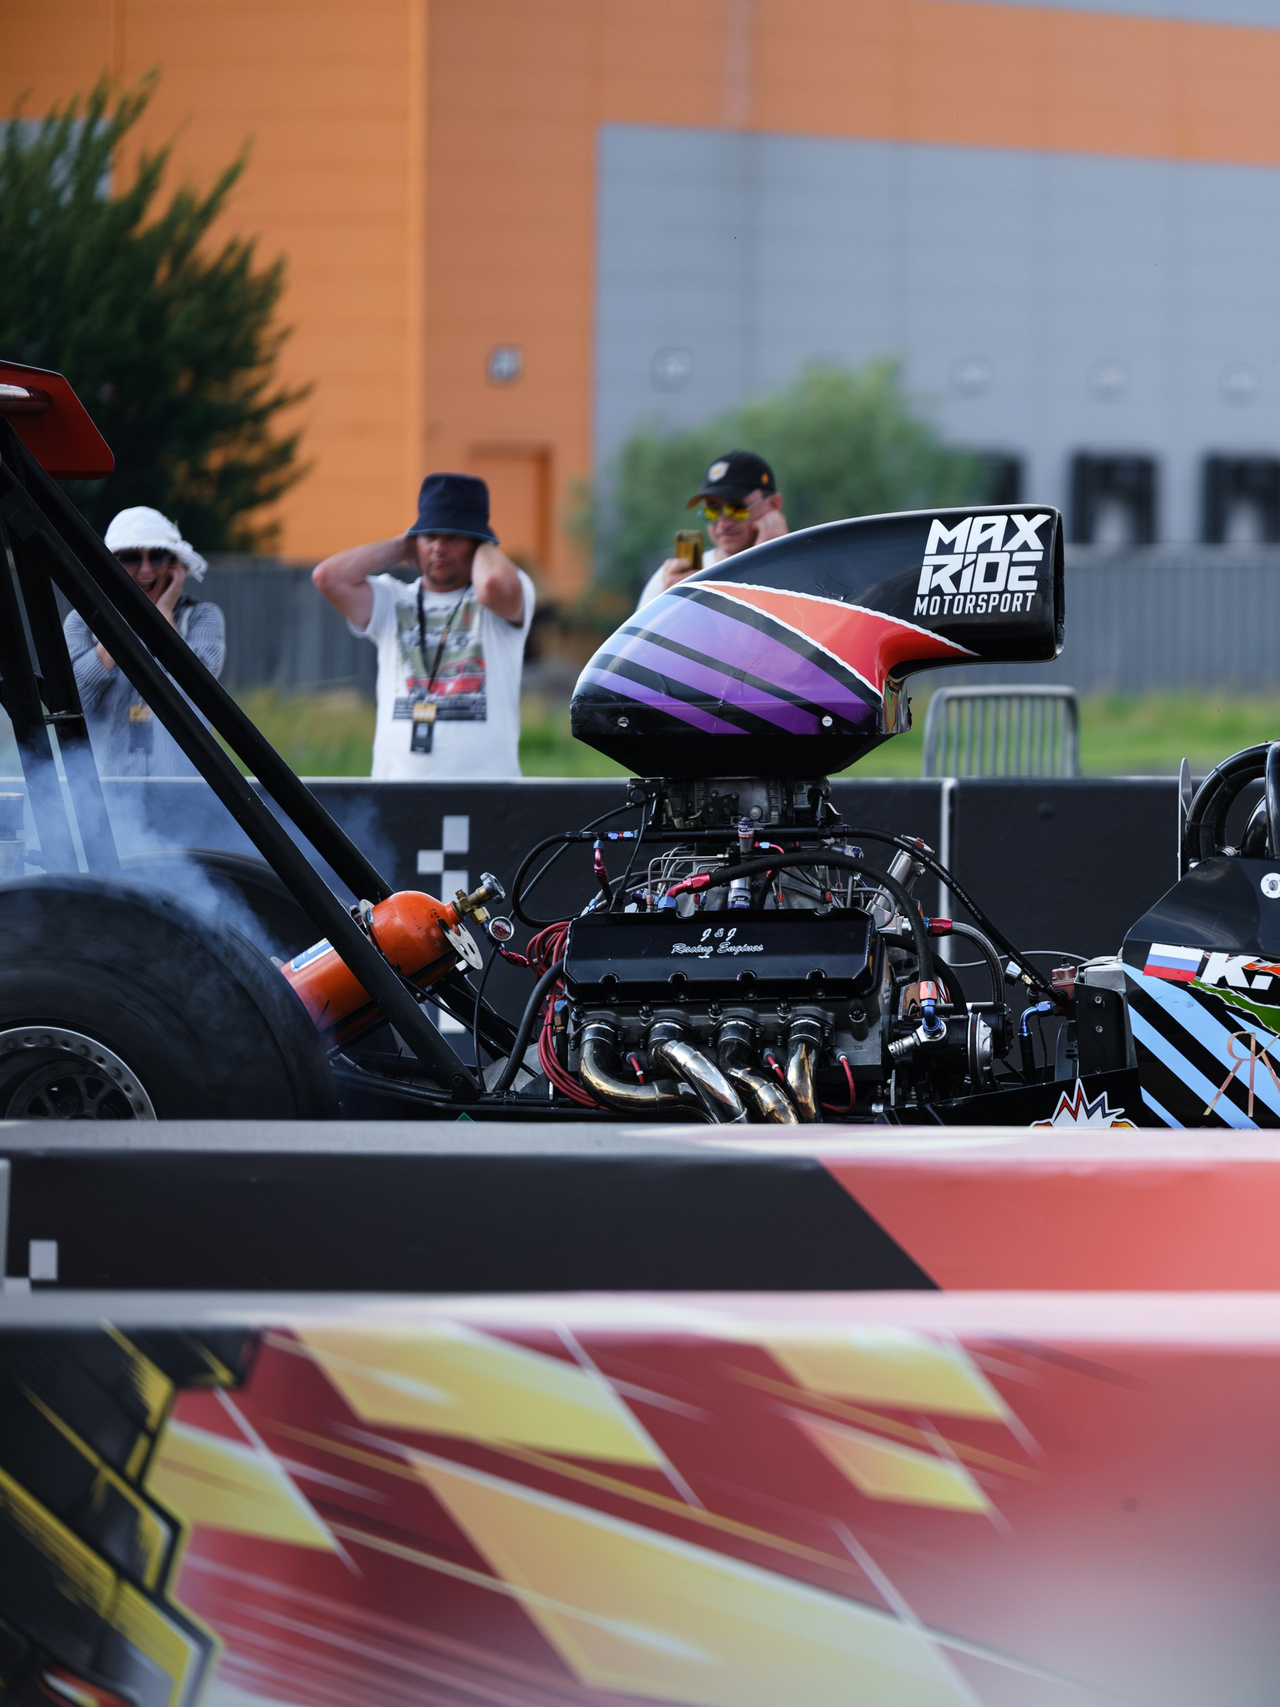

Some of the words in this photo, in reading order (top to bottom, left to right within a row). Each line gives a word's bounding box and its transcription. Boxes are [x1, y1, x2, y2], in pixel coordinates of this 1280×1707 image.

[924, 513, 1052, 555] MAX
[916, 550, 1044, 595] RIDE
[913, 592, 1036, 616] MOTORSPORT
[671, 942, 714, 956] Racing
[717, 941, 764, 956] Engines
[700, 927, 712, 942] J
[725, 927, 737, 941] J
[1200, 952, 1273, 991] K.
